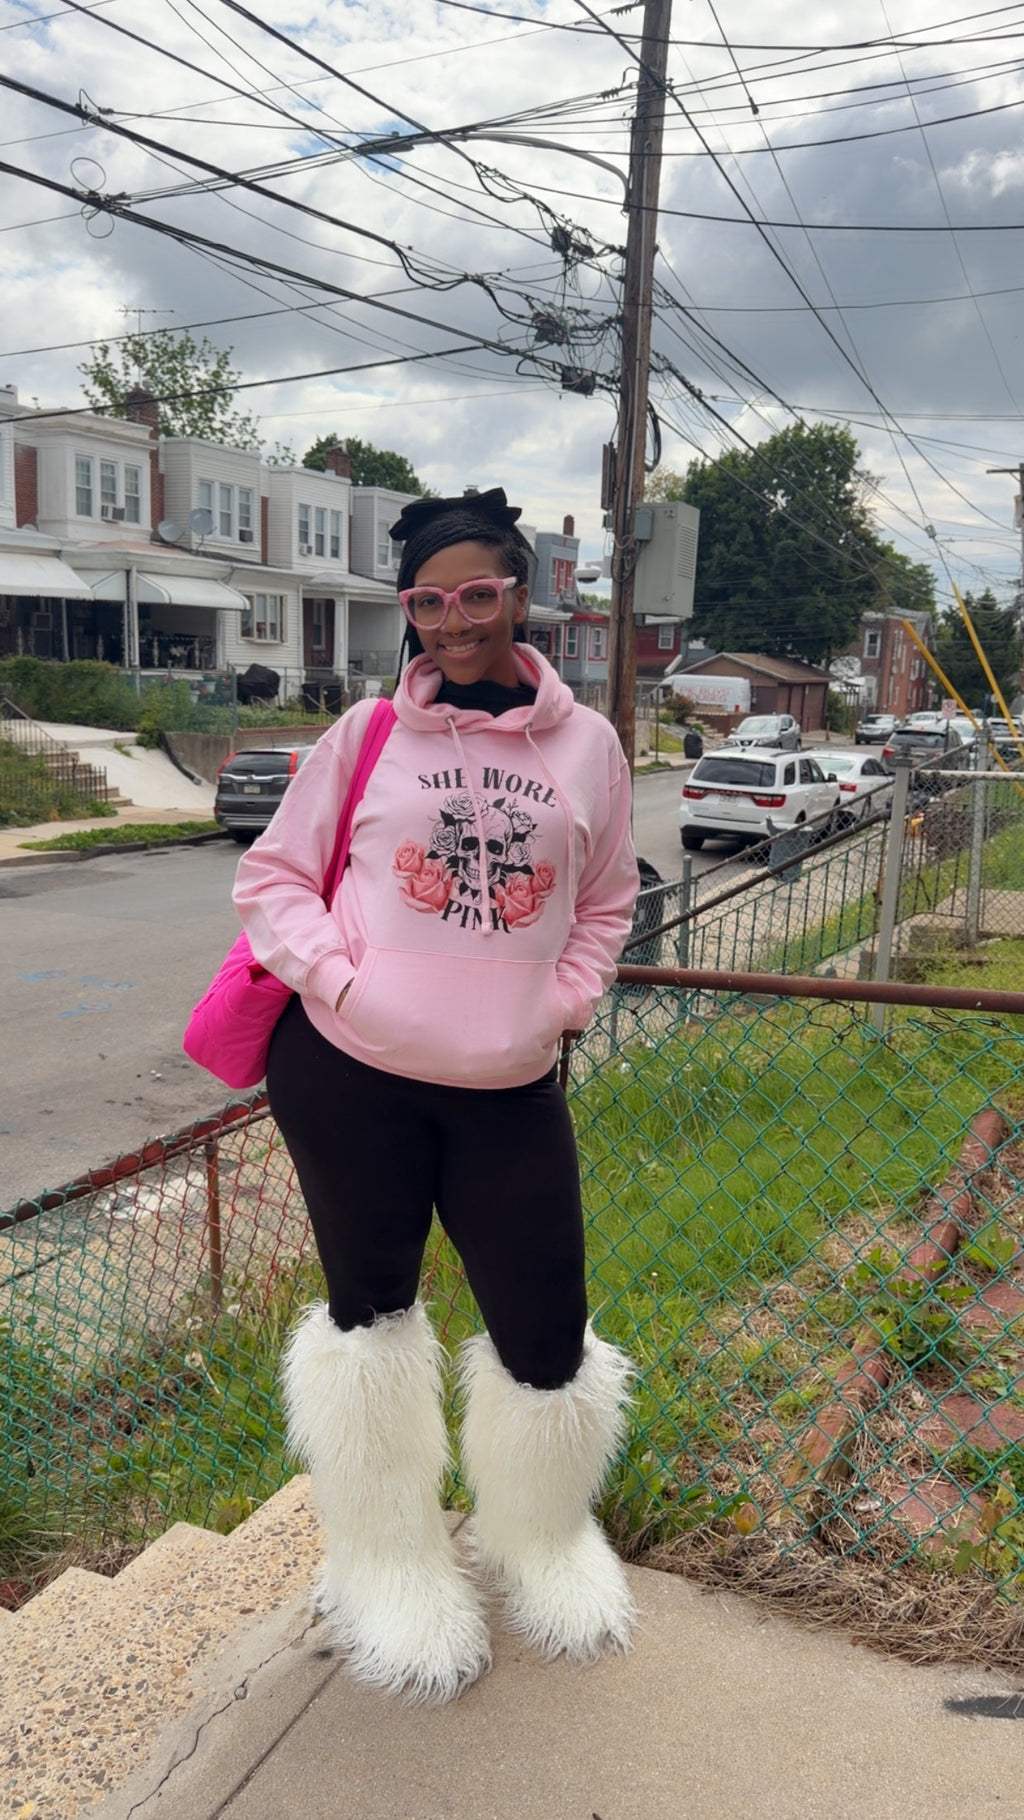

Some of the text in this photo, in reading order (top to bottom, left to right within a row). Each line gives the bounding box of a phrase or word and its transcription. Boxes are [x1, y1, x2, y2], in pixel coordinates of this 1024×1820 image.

[418, 767, 557, 808] SHE WORE
[441, 898, 512, 934] PINK
